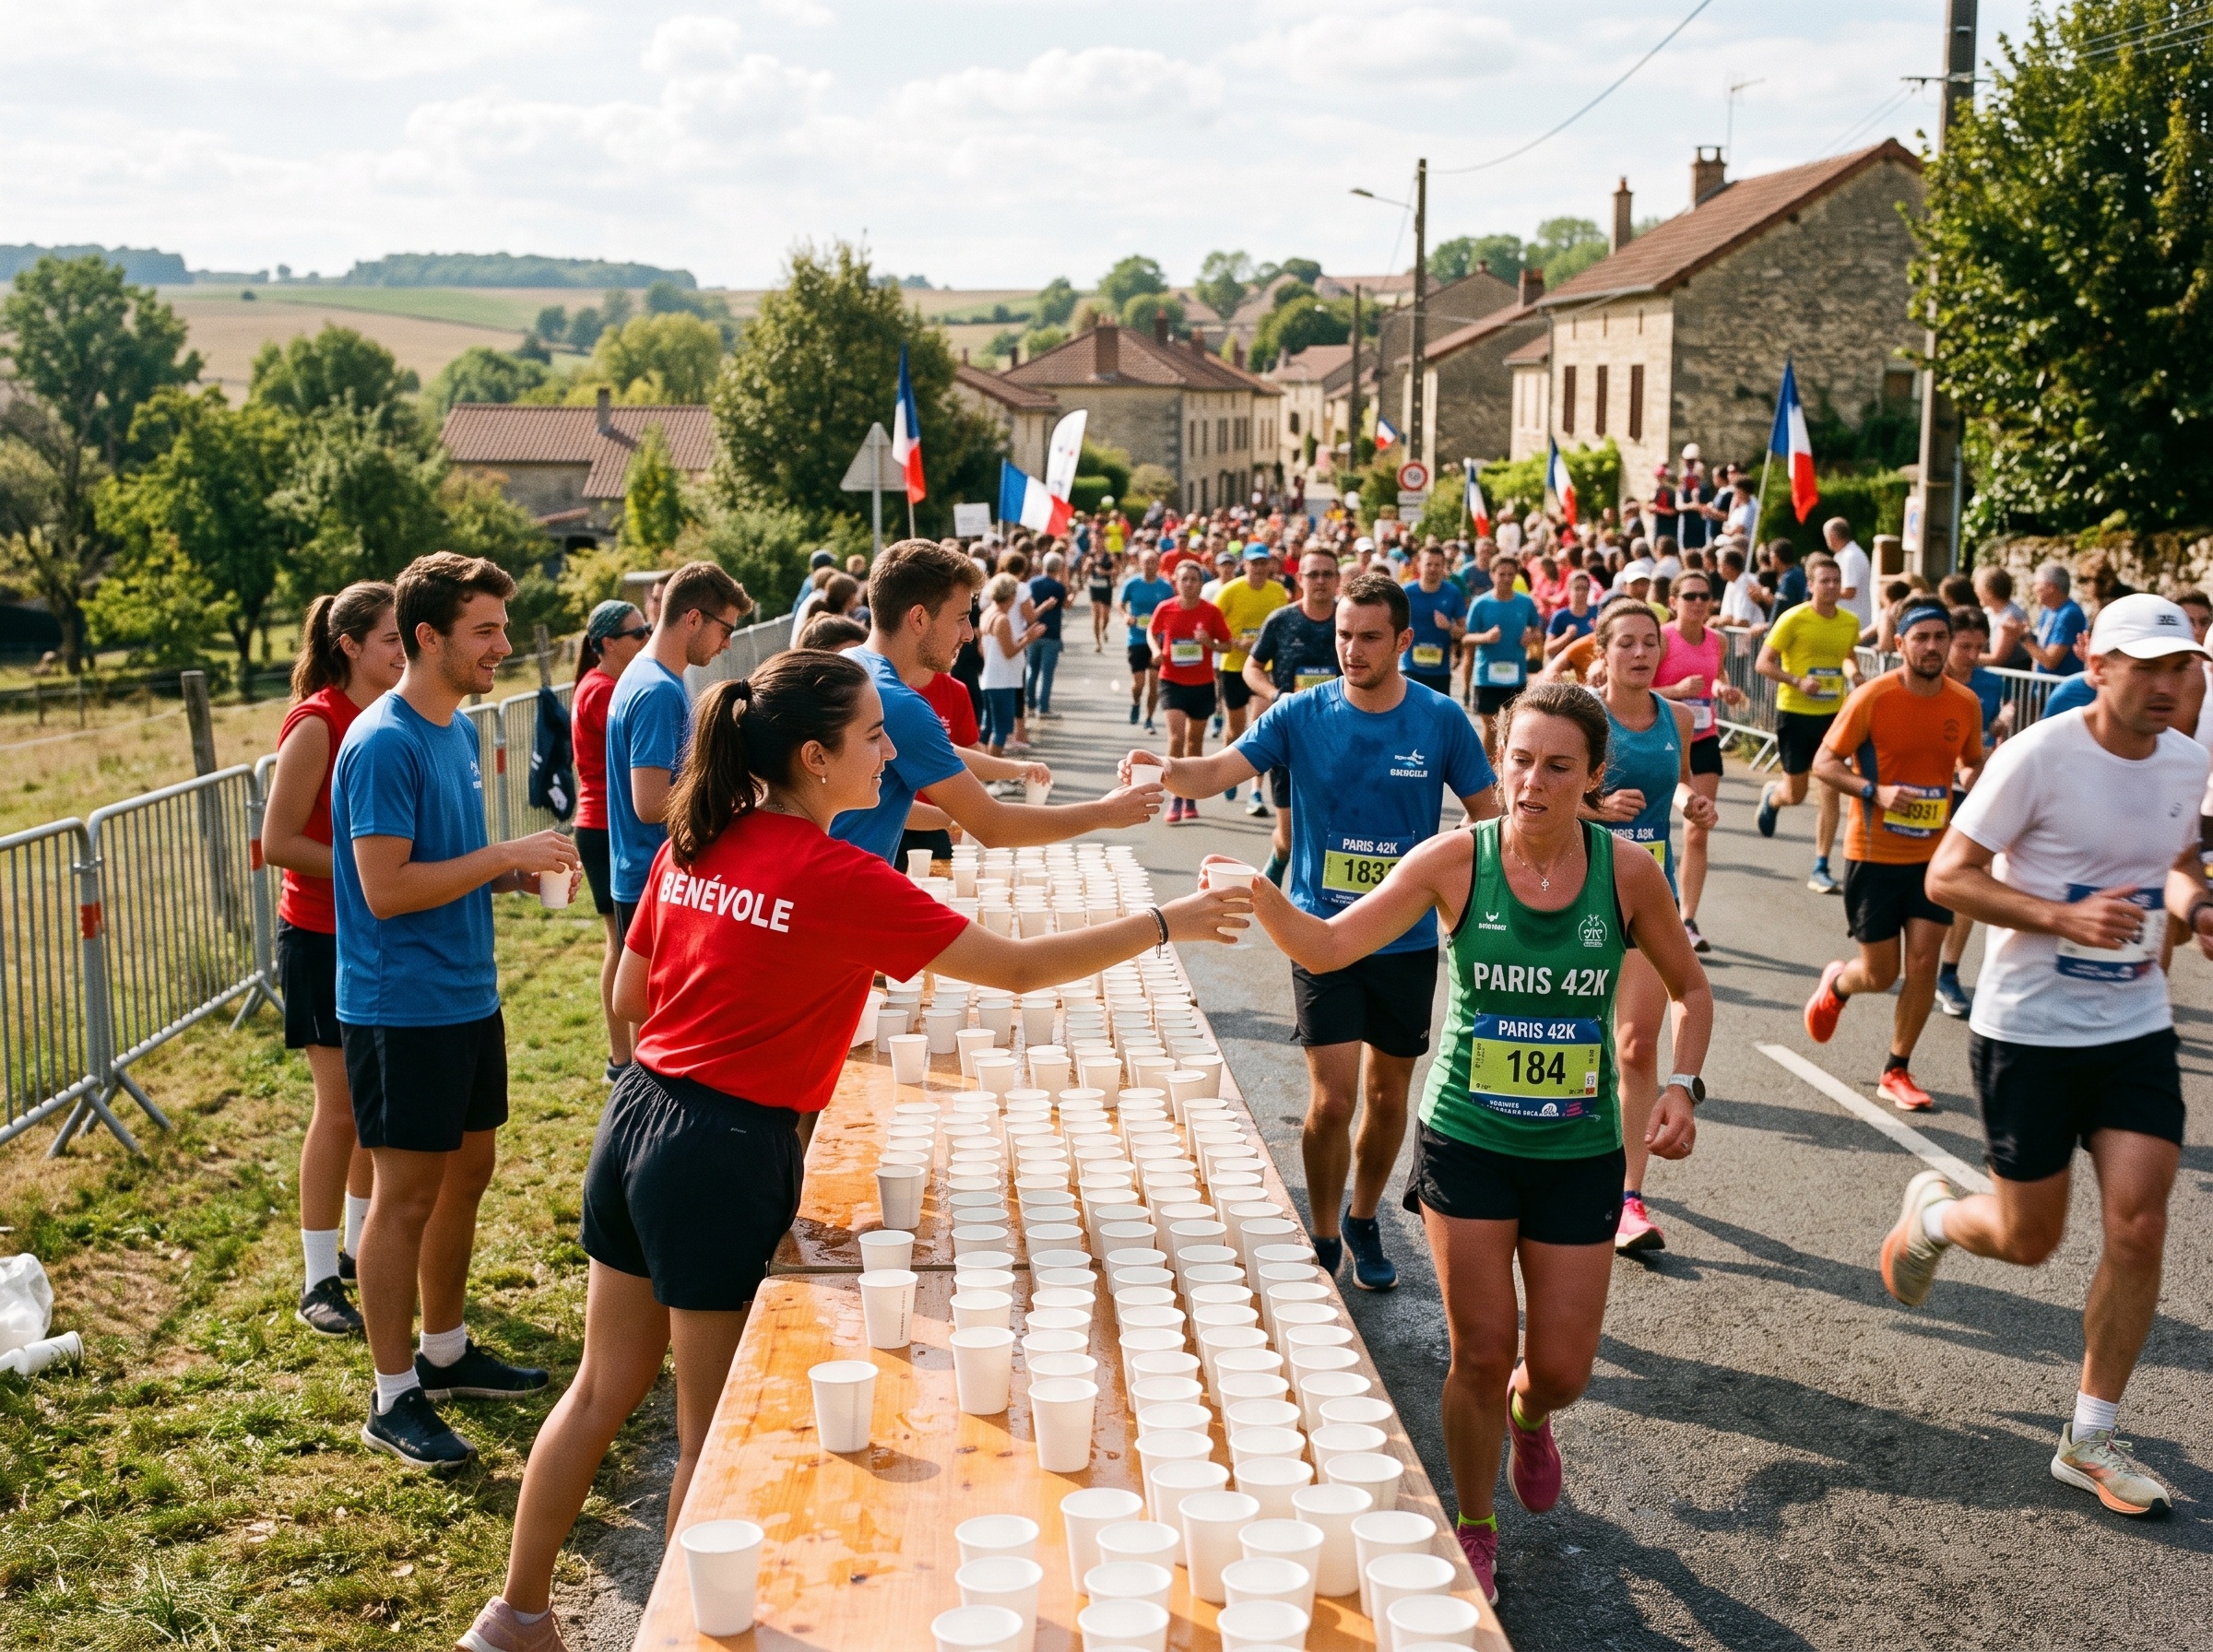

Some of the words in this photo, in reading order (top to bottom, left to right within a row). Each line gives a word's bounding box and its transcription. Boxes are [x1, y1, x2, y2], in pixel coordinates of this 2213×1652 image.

[1343, 838, 1374, 853] PARIS
[1376, 842, 1399, 855] 42K
[1344, 858, 1398, 885] 183
[1473, 962, 1553, 995] PARIS
[1560, 968, 1610, 997] 42K
[1498, 1020, 1544, 1039] PARIS
[1547, 1023, 1577, 1040] 42K
[1507, 1049, 1566, 1085] 184
